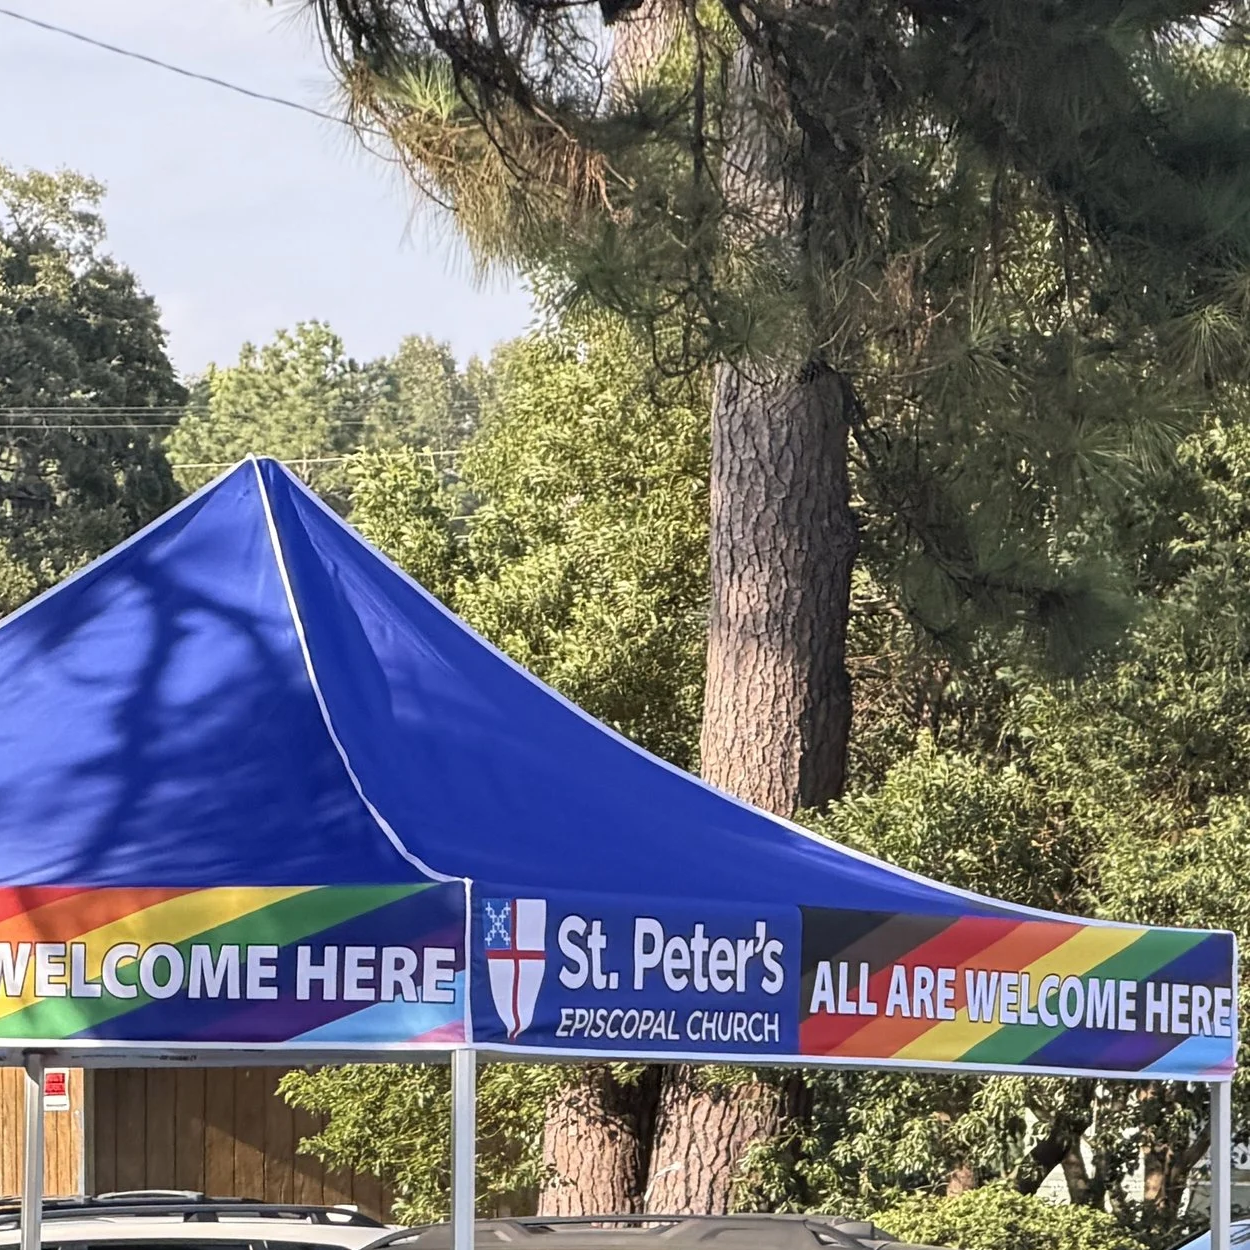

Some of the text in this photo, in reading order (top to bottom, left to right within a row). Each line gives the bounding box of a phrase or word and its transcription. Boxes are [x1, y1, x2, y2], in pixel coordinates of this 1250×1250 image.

[296, 945, 458, 1004] HERE
[558, 915, 619, 990] St.
[555, 1008, 780, 1044] EPISCOPAL CHURCH
[810, 961, 1232, 1037] ALL ARE WELCOME HERE
